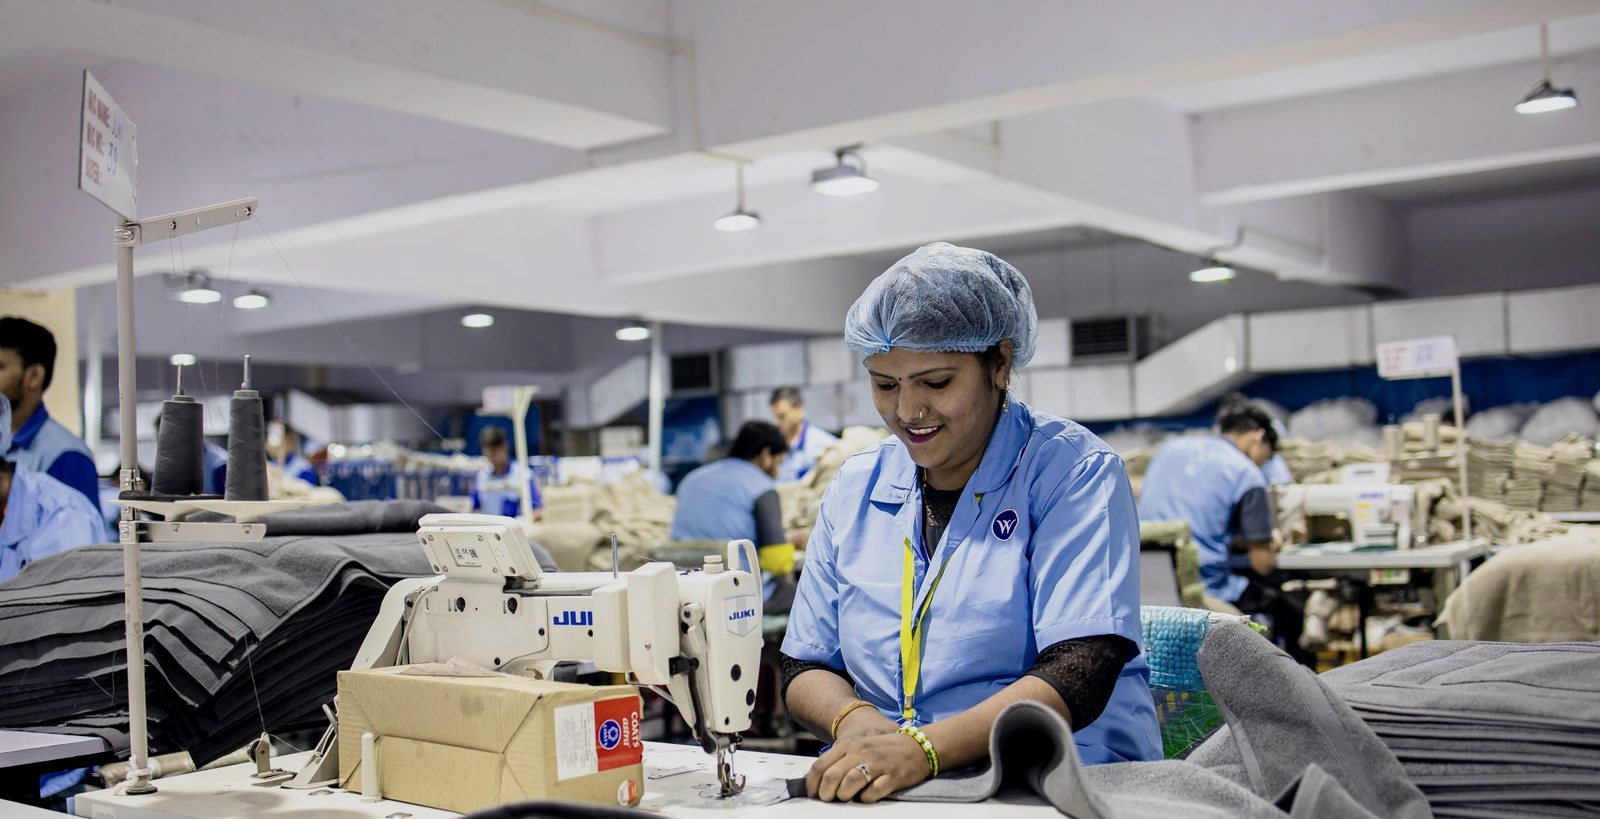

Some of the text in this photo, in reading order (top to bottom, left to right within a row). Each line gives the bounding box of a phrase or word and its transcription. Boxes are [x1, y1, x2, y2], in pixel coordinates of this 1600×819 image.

[996, 519, 1017, 534] W
[729, 609, 755, 620] JUKI
[622, 717, 630, 747] astra
[631, 711, 640, 748] COATS
